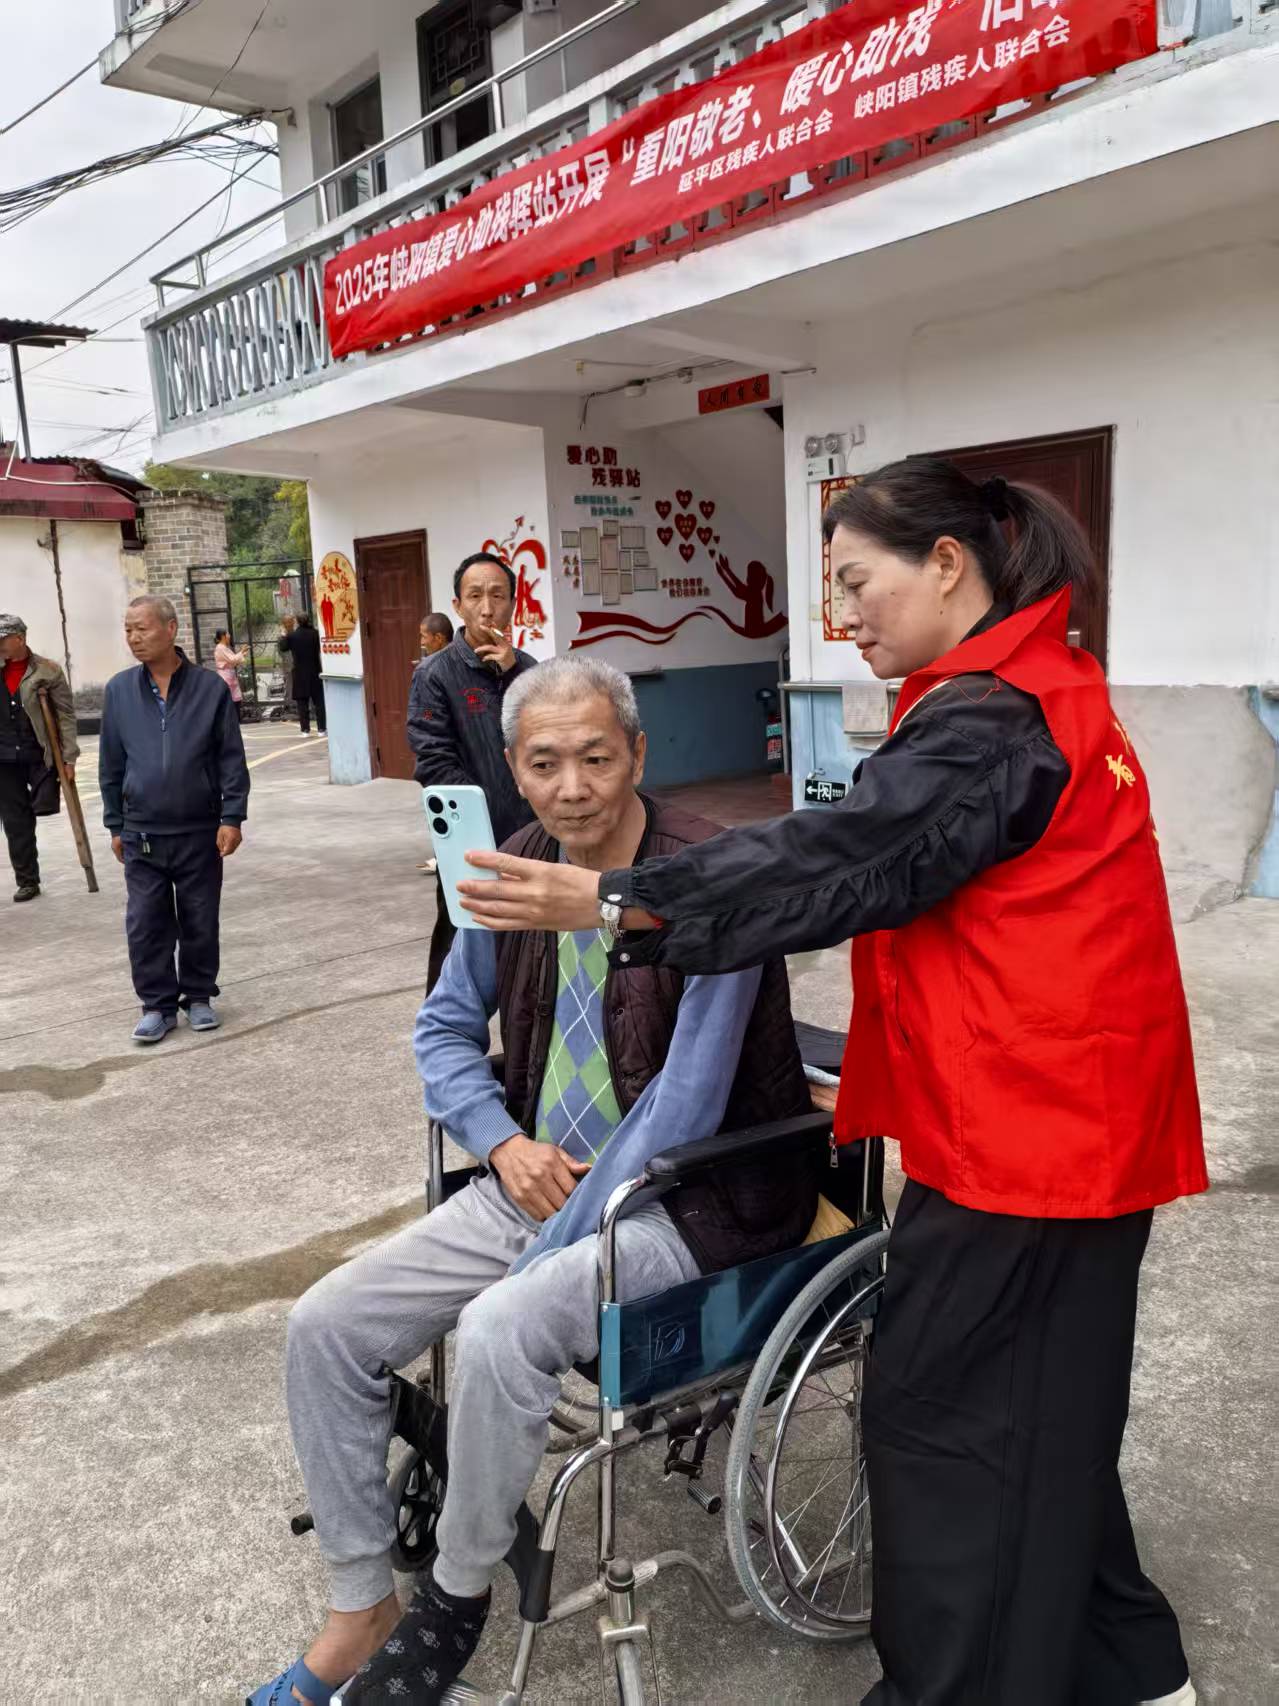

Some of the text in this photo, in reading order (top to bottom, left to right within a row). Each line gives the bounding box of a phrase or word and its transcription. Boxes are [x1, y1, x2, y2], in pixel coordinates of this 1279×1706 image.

[678, 14, 1070, 194] 延平区残疾人联合会 峡阳镇残疾人联合会
[567, 445, 618, 466] 爱心助
[592, 467, 641, 488] 残驿站
